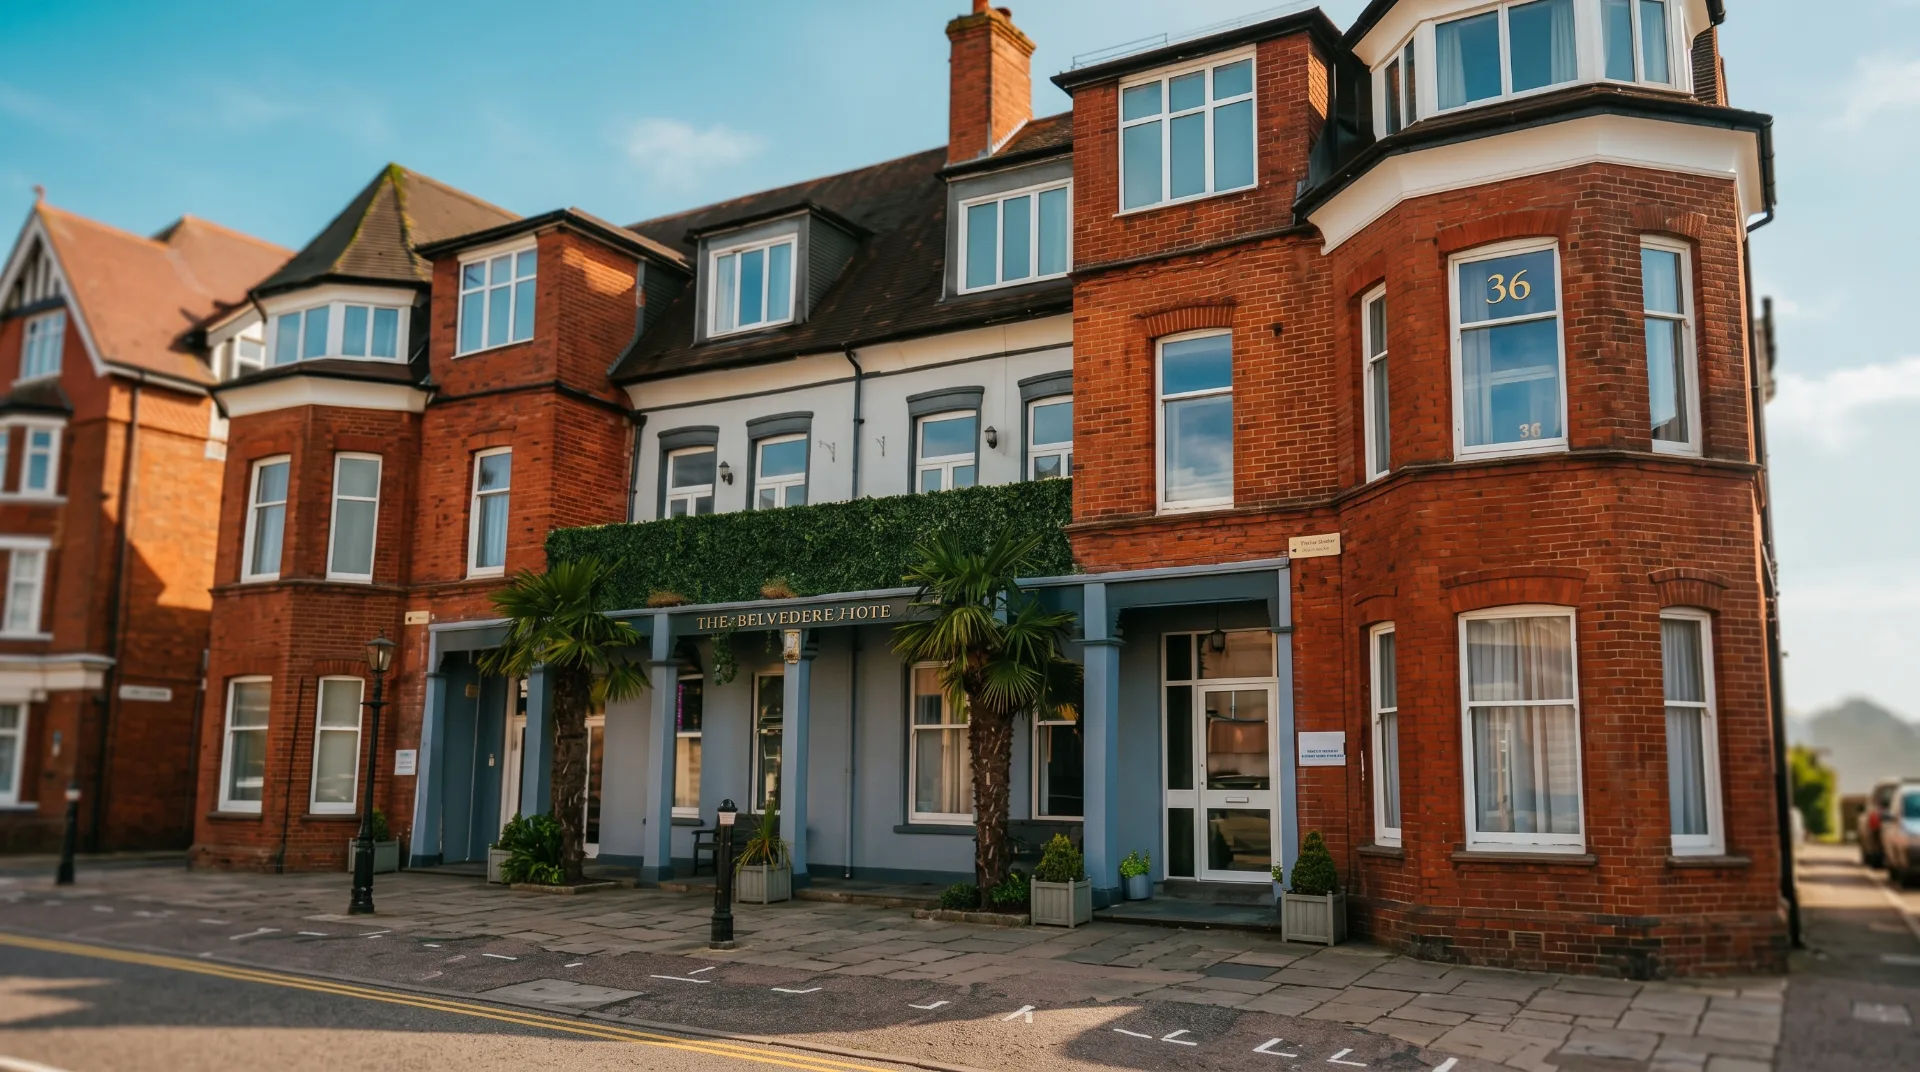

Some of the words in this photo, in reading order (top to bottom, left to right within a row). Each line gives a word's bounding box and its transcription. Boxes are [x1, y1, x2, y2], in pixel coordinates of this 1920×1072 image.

[1485, 269, 1531, 304] 36
[1519, 422, 1542, 439] 36
[696, 615, 728, 630] THE
[738, 608, 834, 627] BELVEDERE
